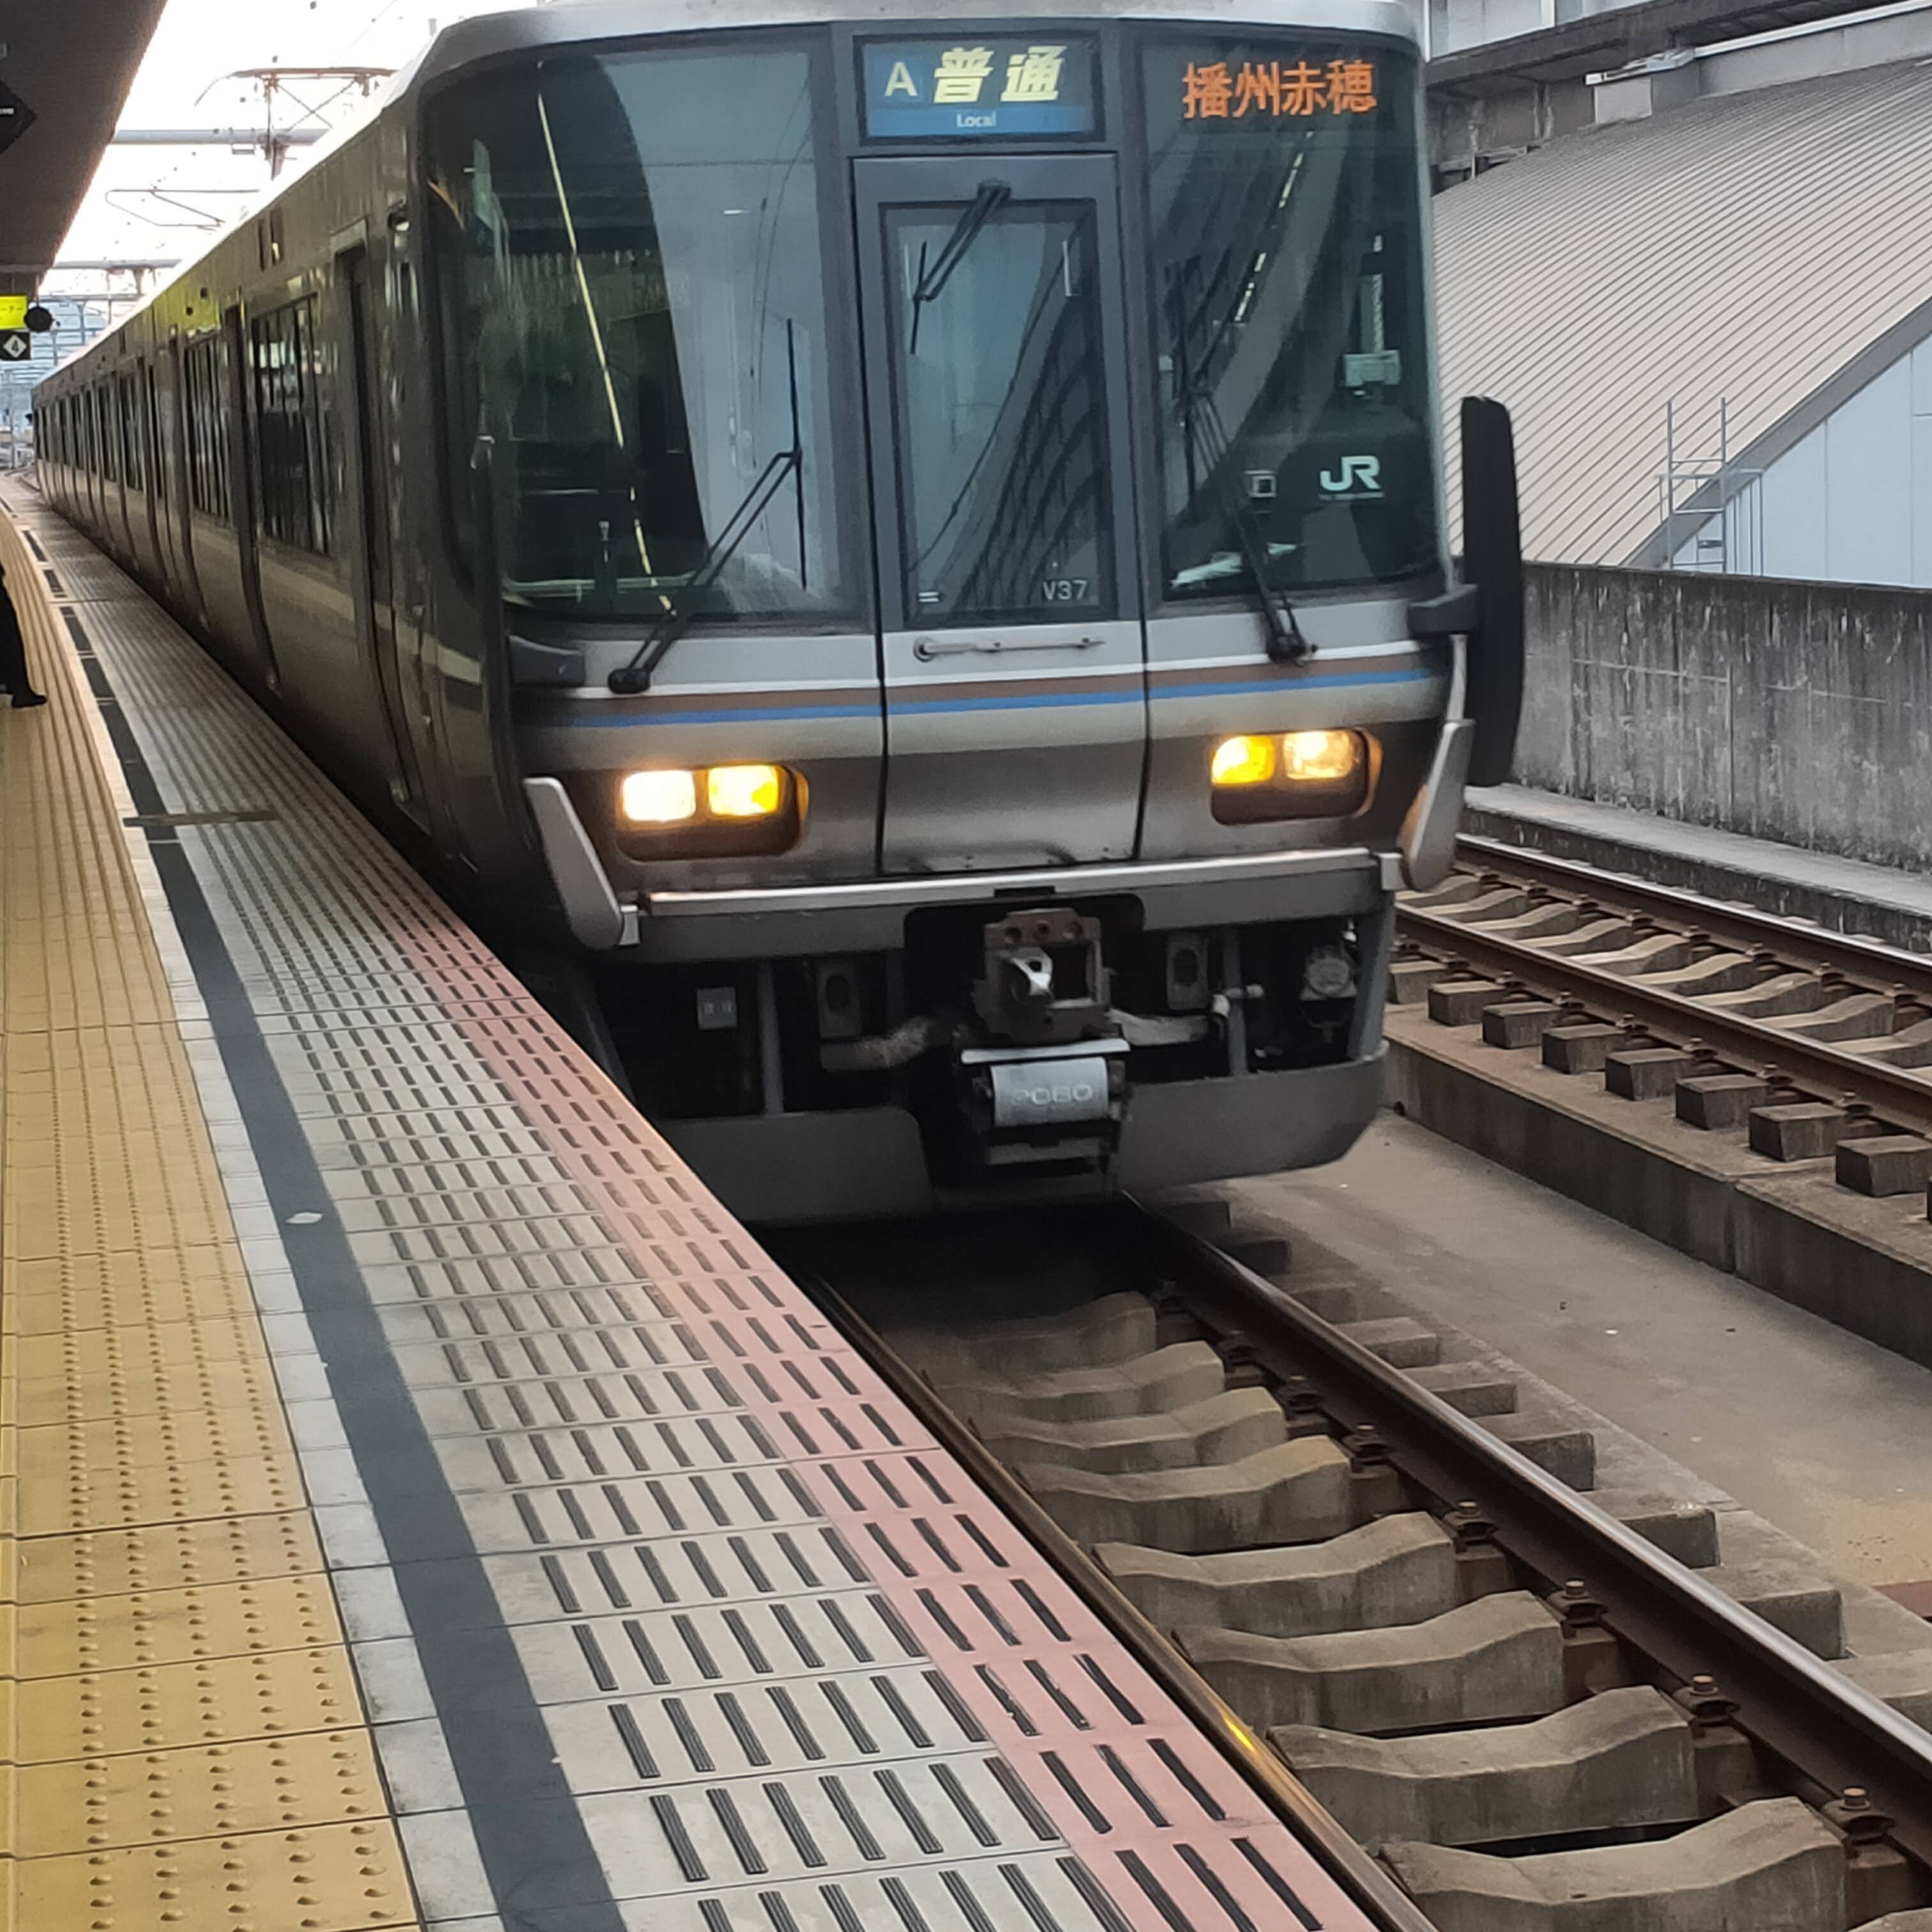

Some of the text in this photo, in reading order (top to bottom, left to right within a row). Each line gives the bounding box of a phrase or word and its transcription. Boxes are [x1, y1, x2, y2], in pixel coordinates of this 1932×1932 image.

[885, 46, 1067, 104] A 普通
[1182, 59, 1377, 118] 播州赤穂
[956, 111, 996, 128] Local
[1320, 455, 1381, 491] JR
[1043, 580, 1088, 600] V37
